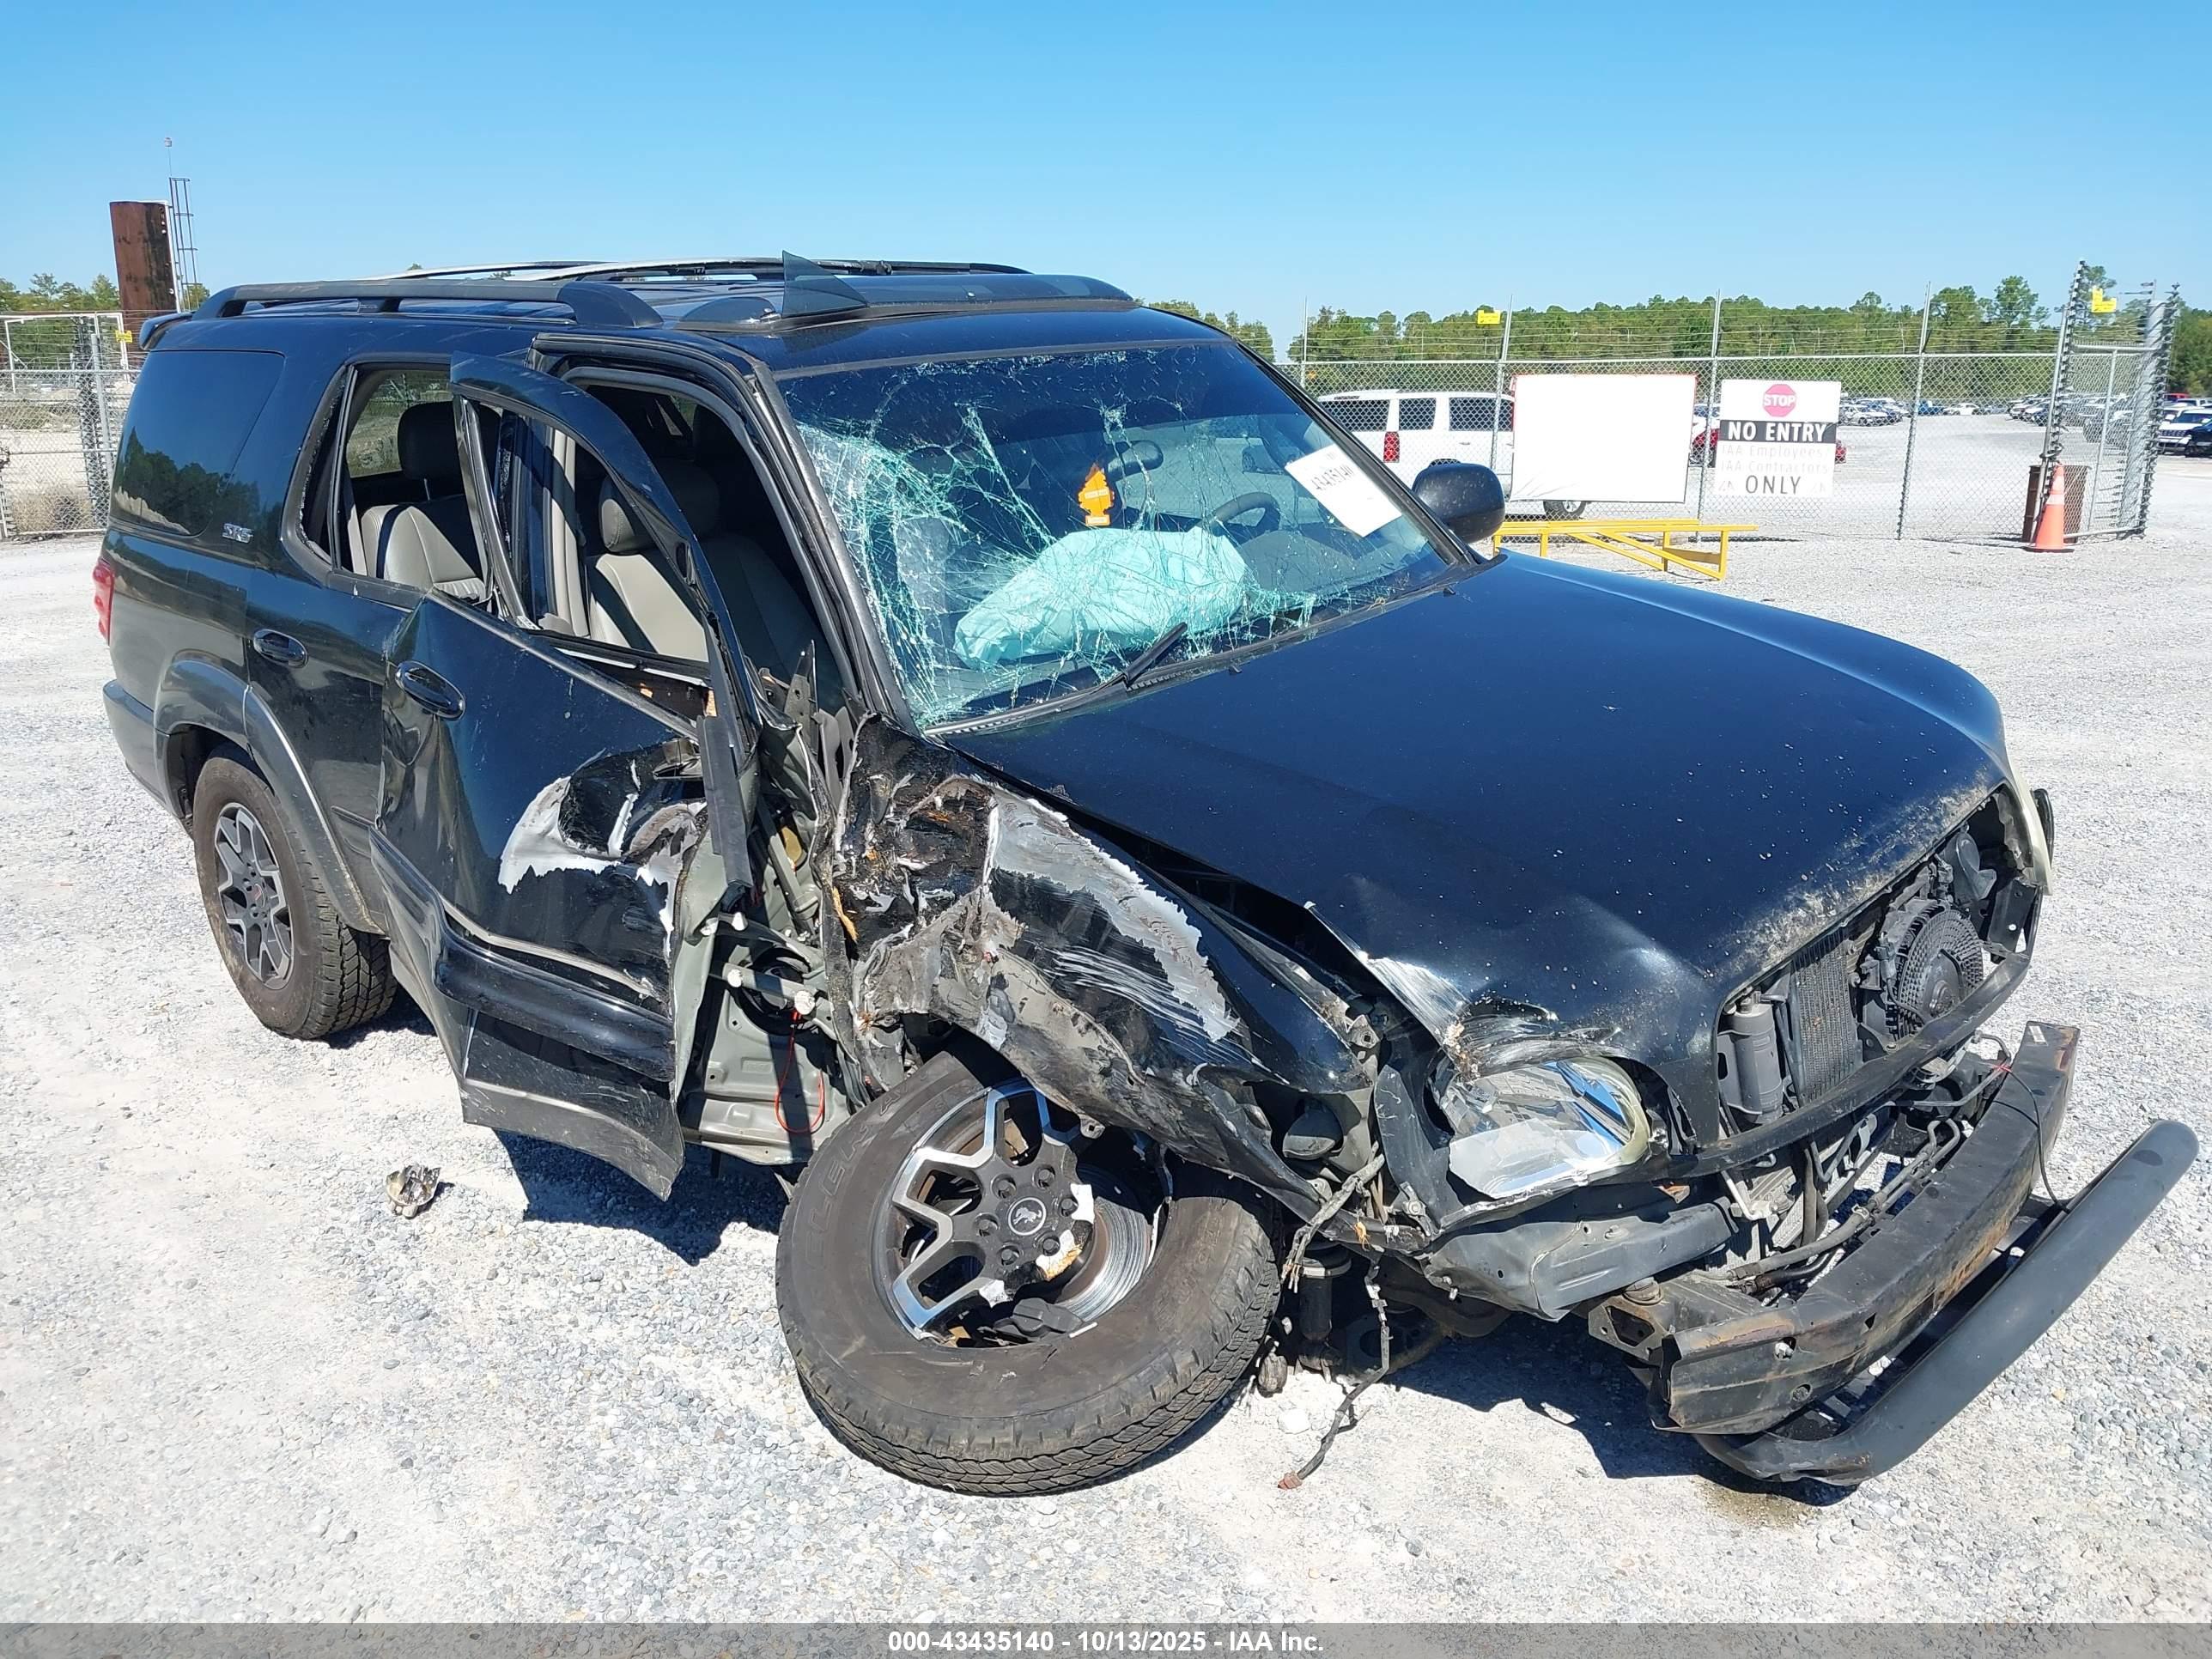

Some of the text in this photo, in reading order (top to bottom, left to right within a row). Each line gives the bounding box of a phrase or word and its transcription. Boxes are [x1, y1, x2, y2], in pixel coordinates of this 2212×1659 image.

[1763, 395, 1796, 407] STOP
[1728, 421, 1826, 443] NO ENTRY
[1747, 475, 1802, 495] ONLY
